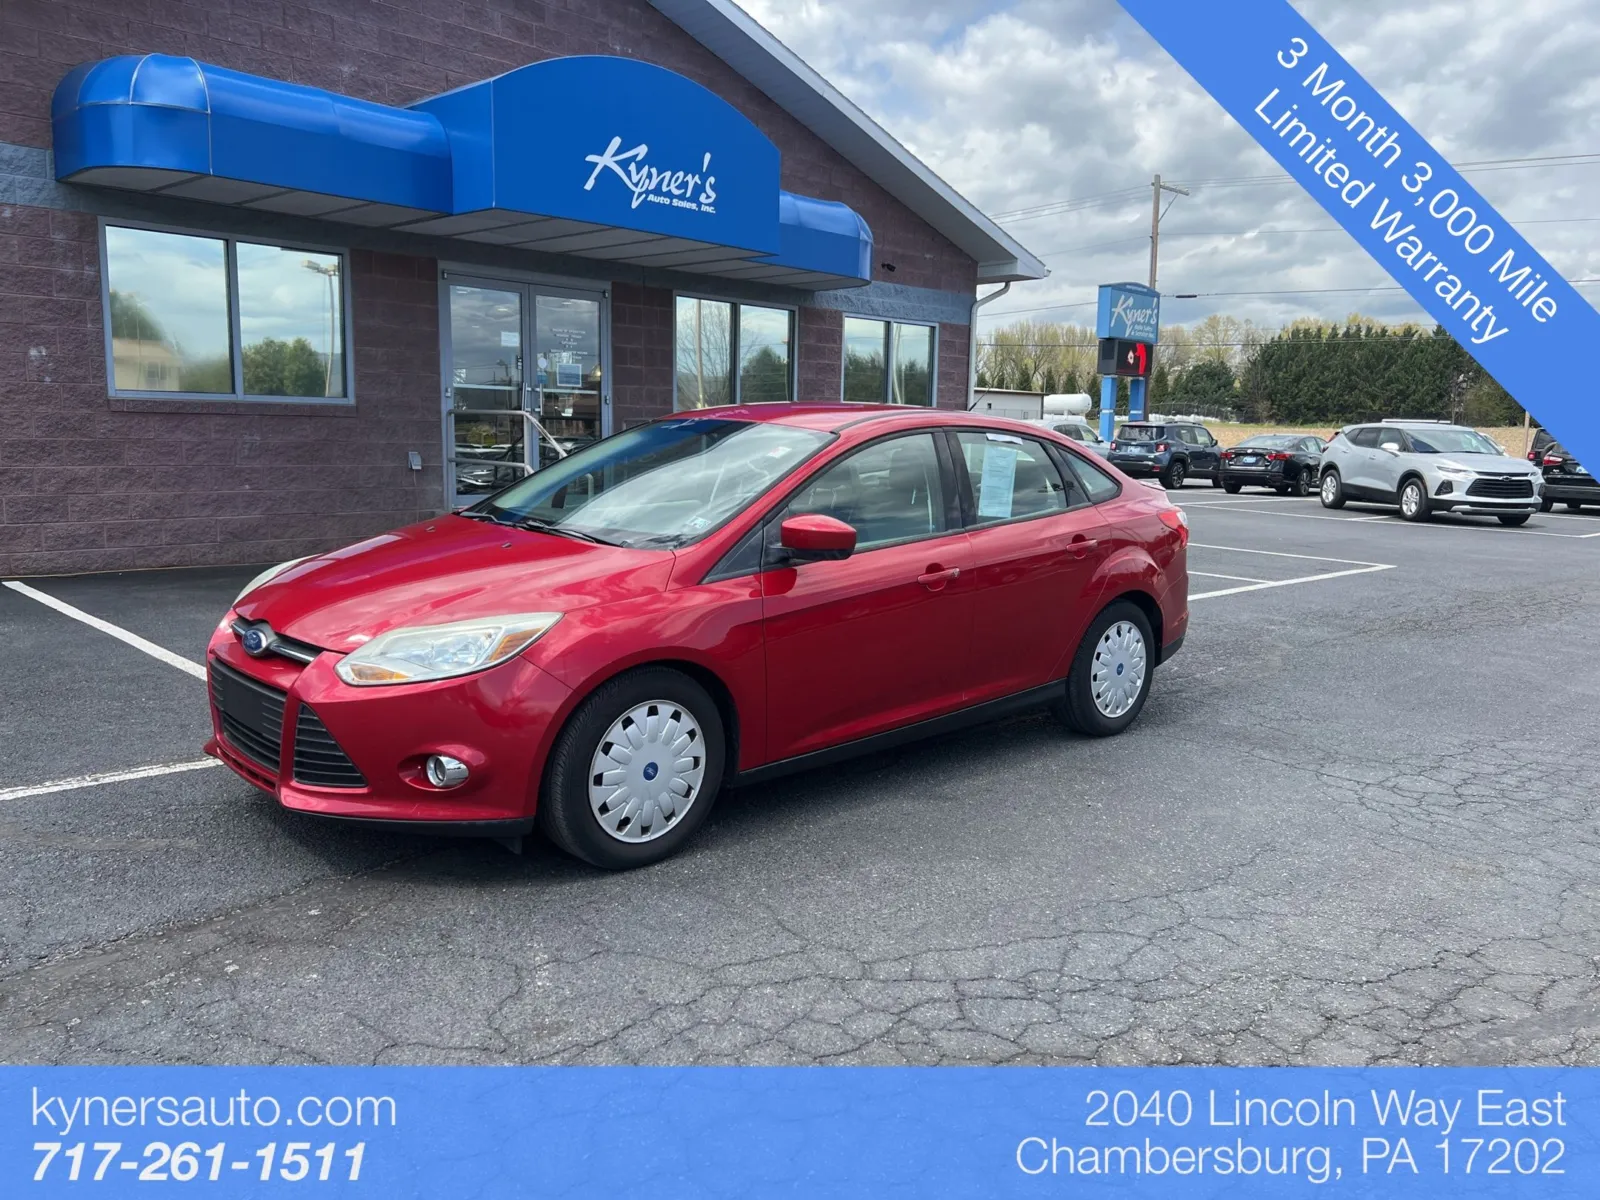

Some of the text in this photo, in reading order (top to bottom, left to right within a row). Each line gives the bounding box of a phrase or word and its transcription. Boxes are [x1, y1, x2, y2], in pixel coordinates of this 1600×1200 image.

[584, 136, 717, 209] Kyner's
[647, 193, 716, 214] Auto Sales, Inc.
[1110, 294, 1158, 338] Kyner's
